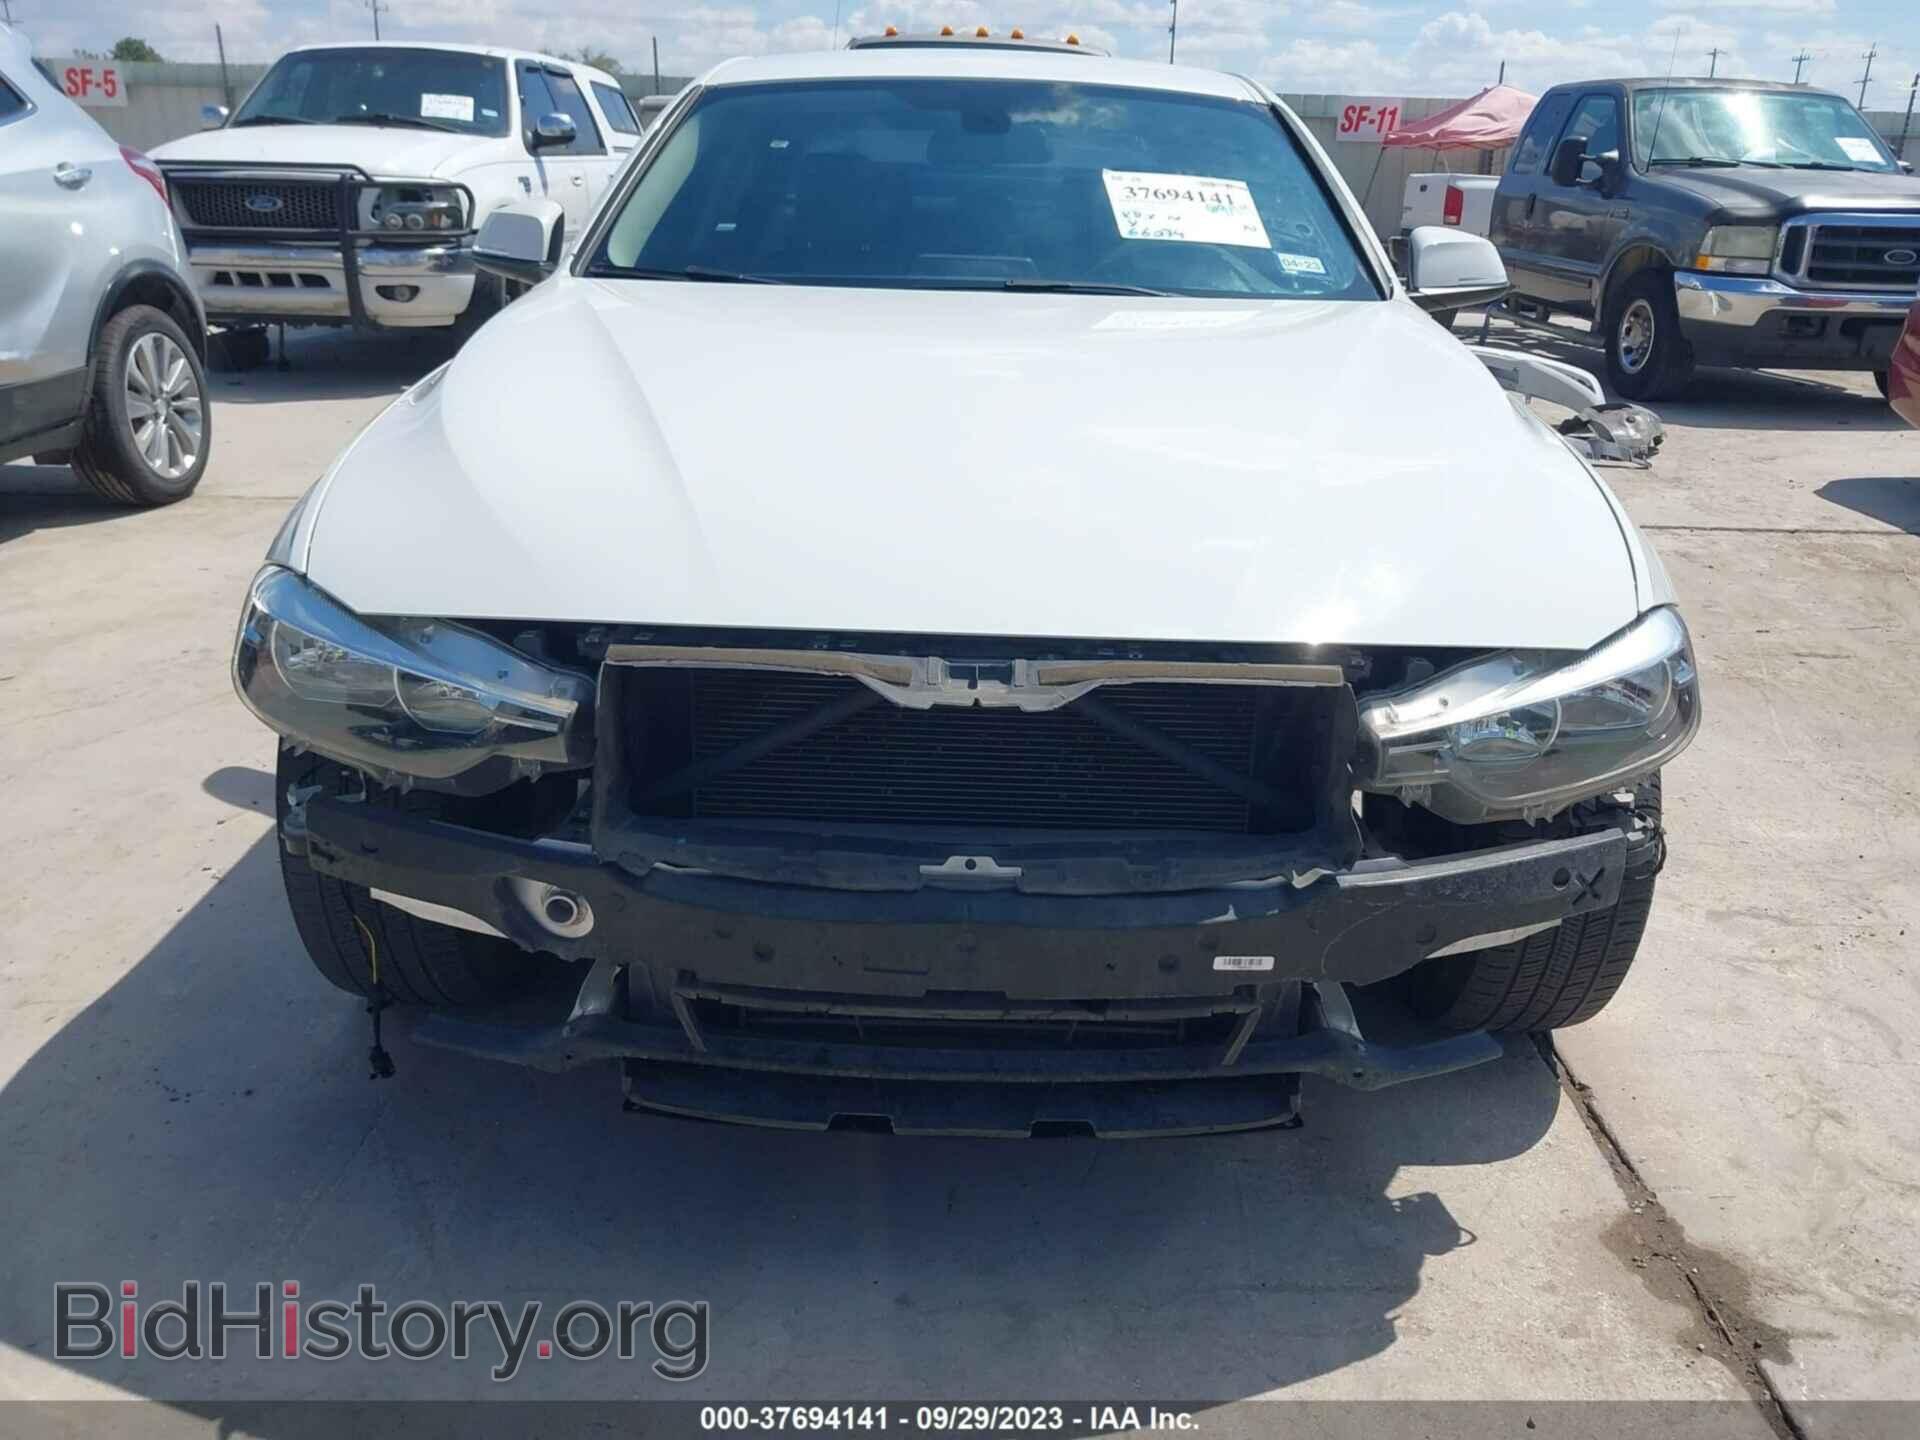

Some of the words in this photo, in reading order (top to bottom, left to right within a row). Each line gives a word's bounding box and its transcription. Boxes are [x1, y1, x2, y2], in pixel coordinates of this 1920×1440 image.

[65, 67, 117, 97] SF-5
[1340, 105, 1398, 133] SF-11
[1123, 186, 1233, 205] 37694141
